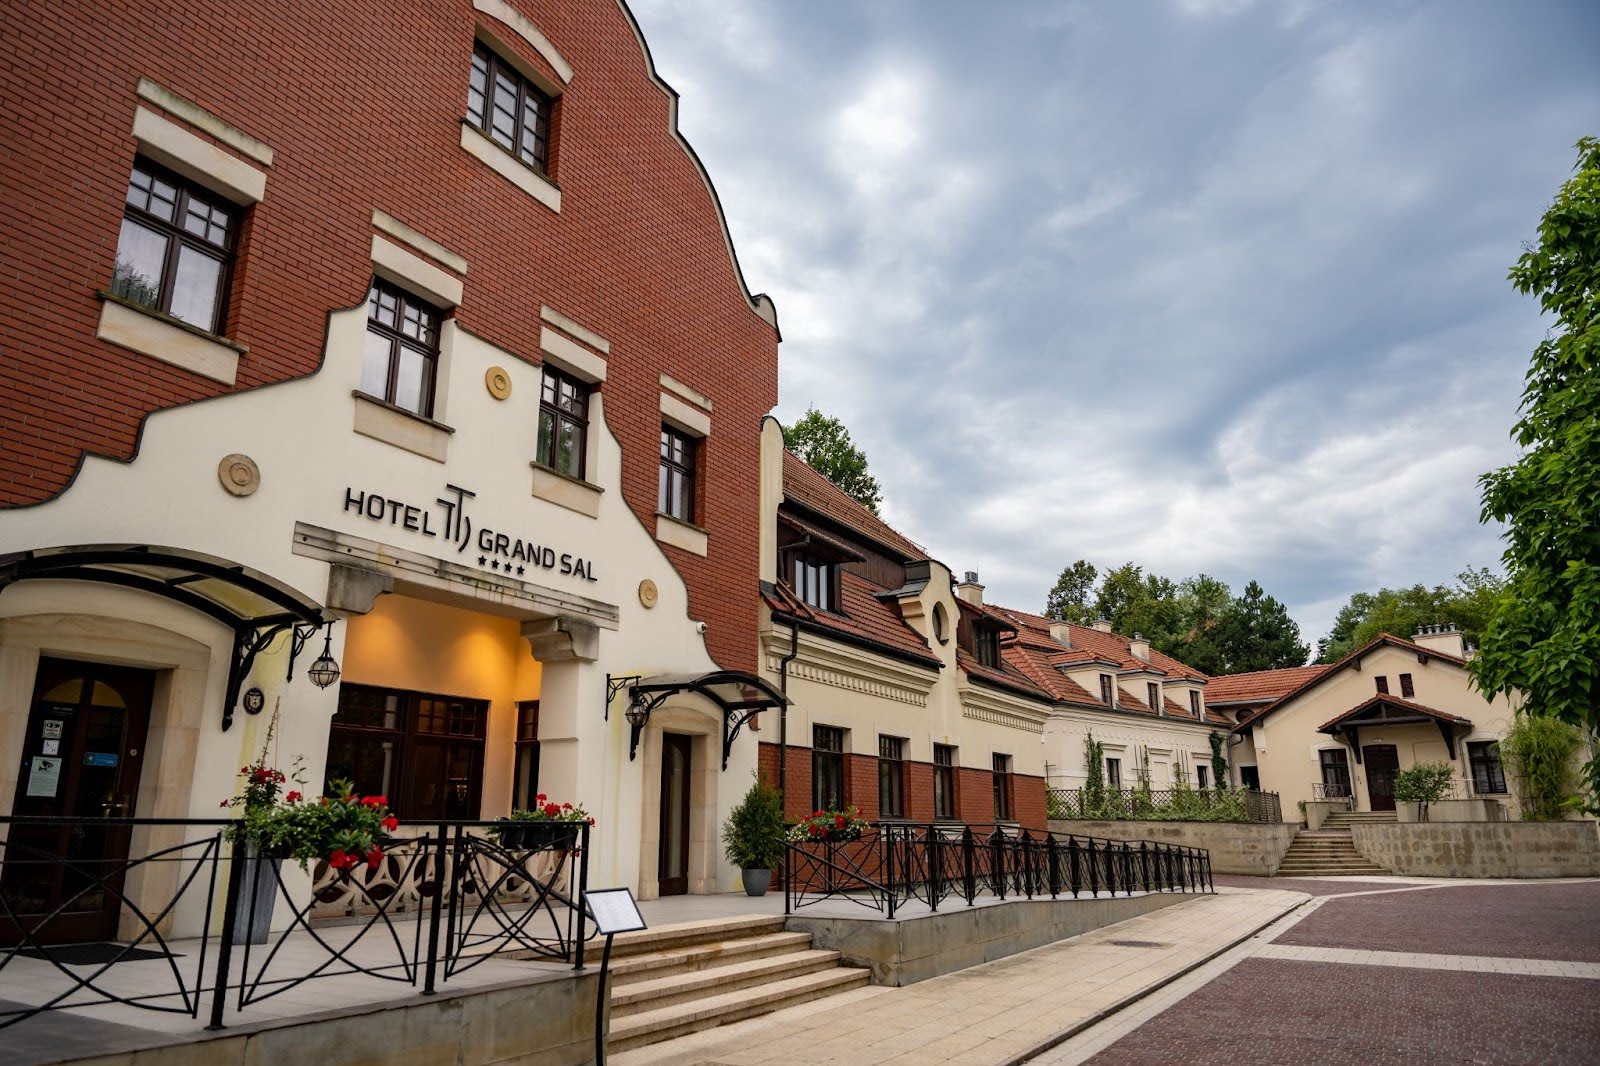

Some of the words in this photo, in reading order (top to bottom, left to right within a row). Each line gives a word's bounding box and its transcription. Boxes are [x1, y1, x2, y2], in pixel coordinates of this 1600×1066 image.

[344, 487, 436, 537] HOTEL
[478, 528, 556, 570] GRAND
[560, 553, 598, 582] SAL
